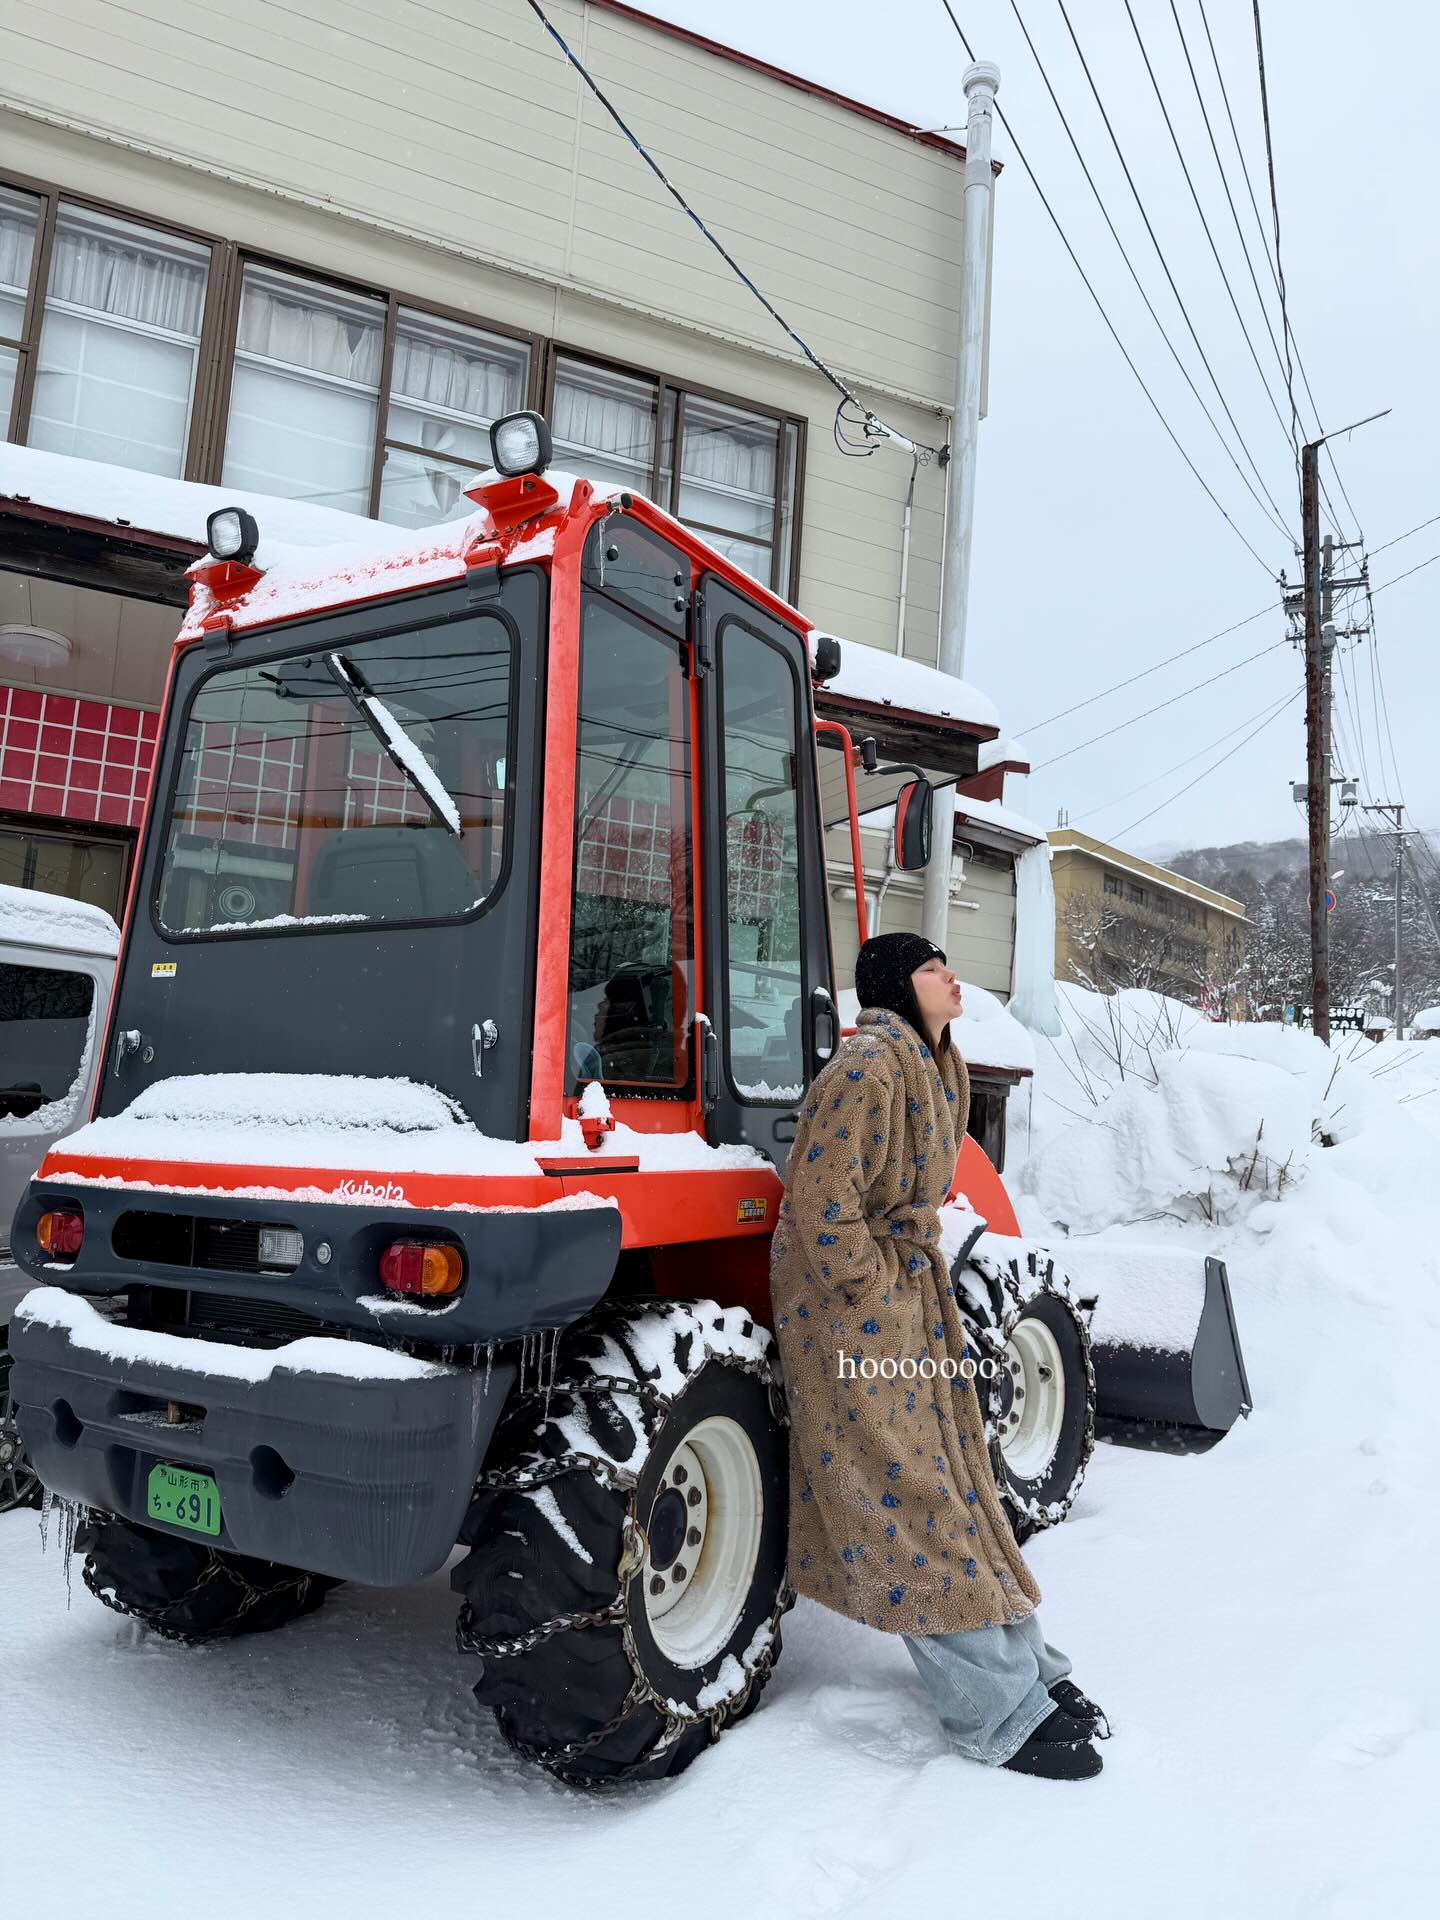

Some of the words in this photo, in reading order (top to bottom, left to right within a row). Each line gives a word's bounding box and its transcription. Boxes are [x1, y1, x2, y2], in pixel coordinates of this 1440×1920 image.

[1329, 1007, 1364, 1018] SHOP
[339, 1179, 404, 1200] Kubota
[168, 1473, 200, 1491] 山形市
